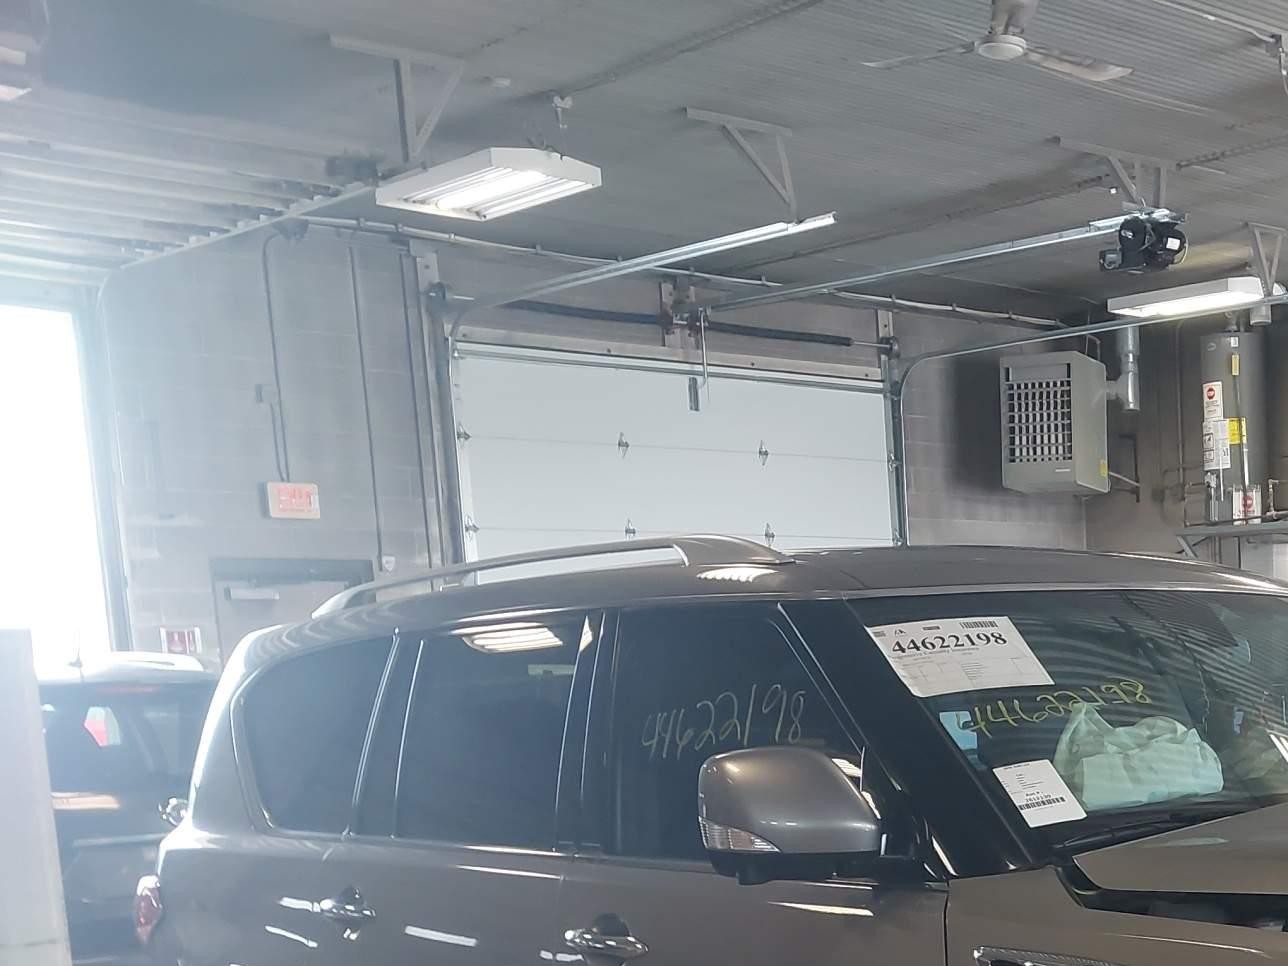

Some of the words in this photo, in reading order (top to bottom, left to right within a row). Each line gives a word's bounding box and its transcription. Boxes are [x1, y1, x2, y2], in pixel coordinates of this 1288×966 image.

[891, 631, 1008, 655] 44622198
[641, 684, 806, 760] 44622198
[957, 677, 1153, 739] 44622198
